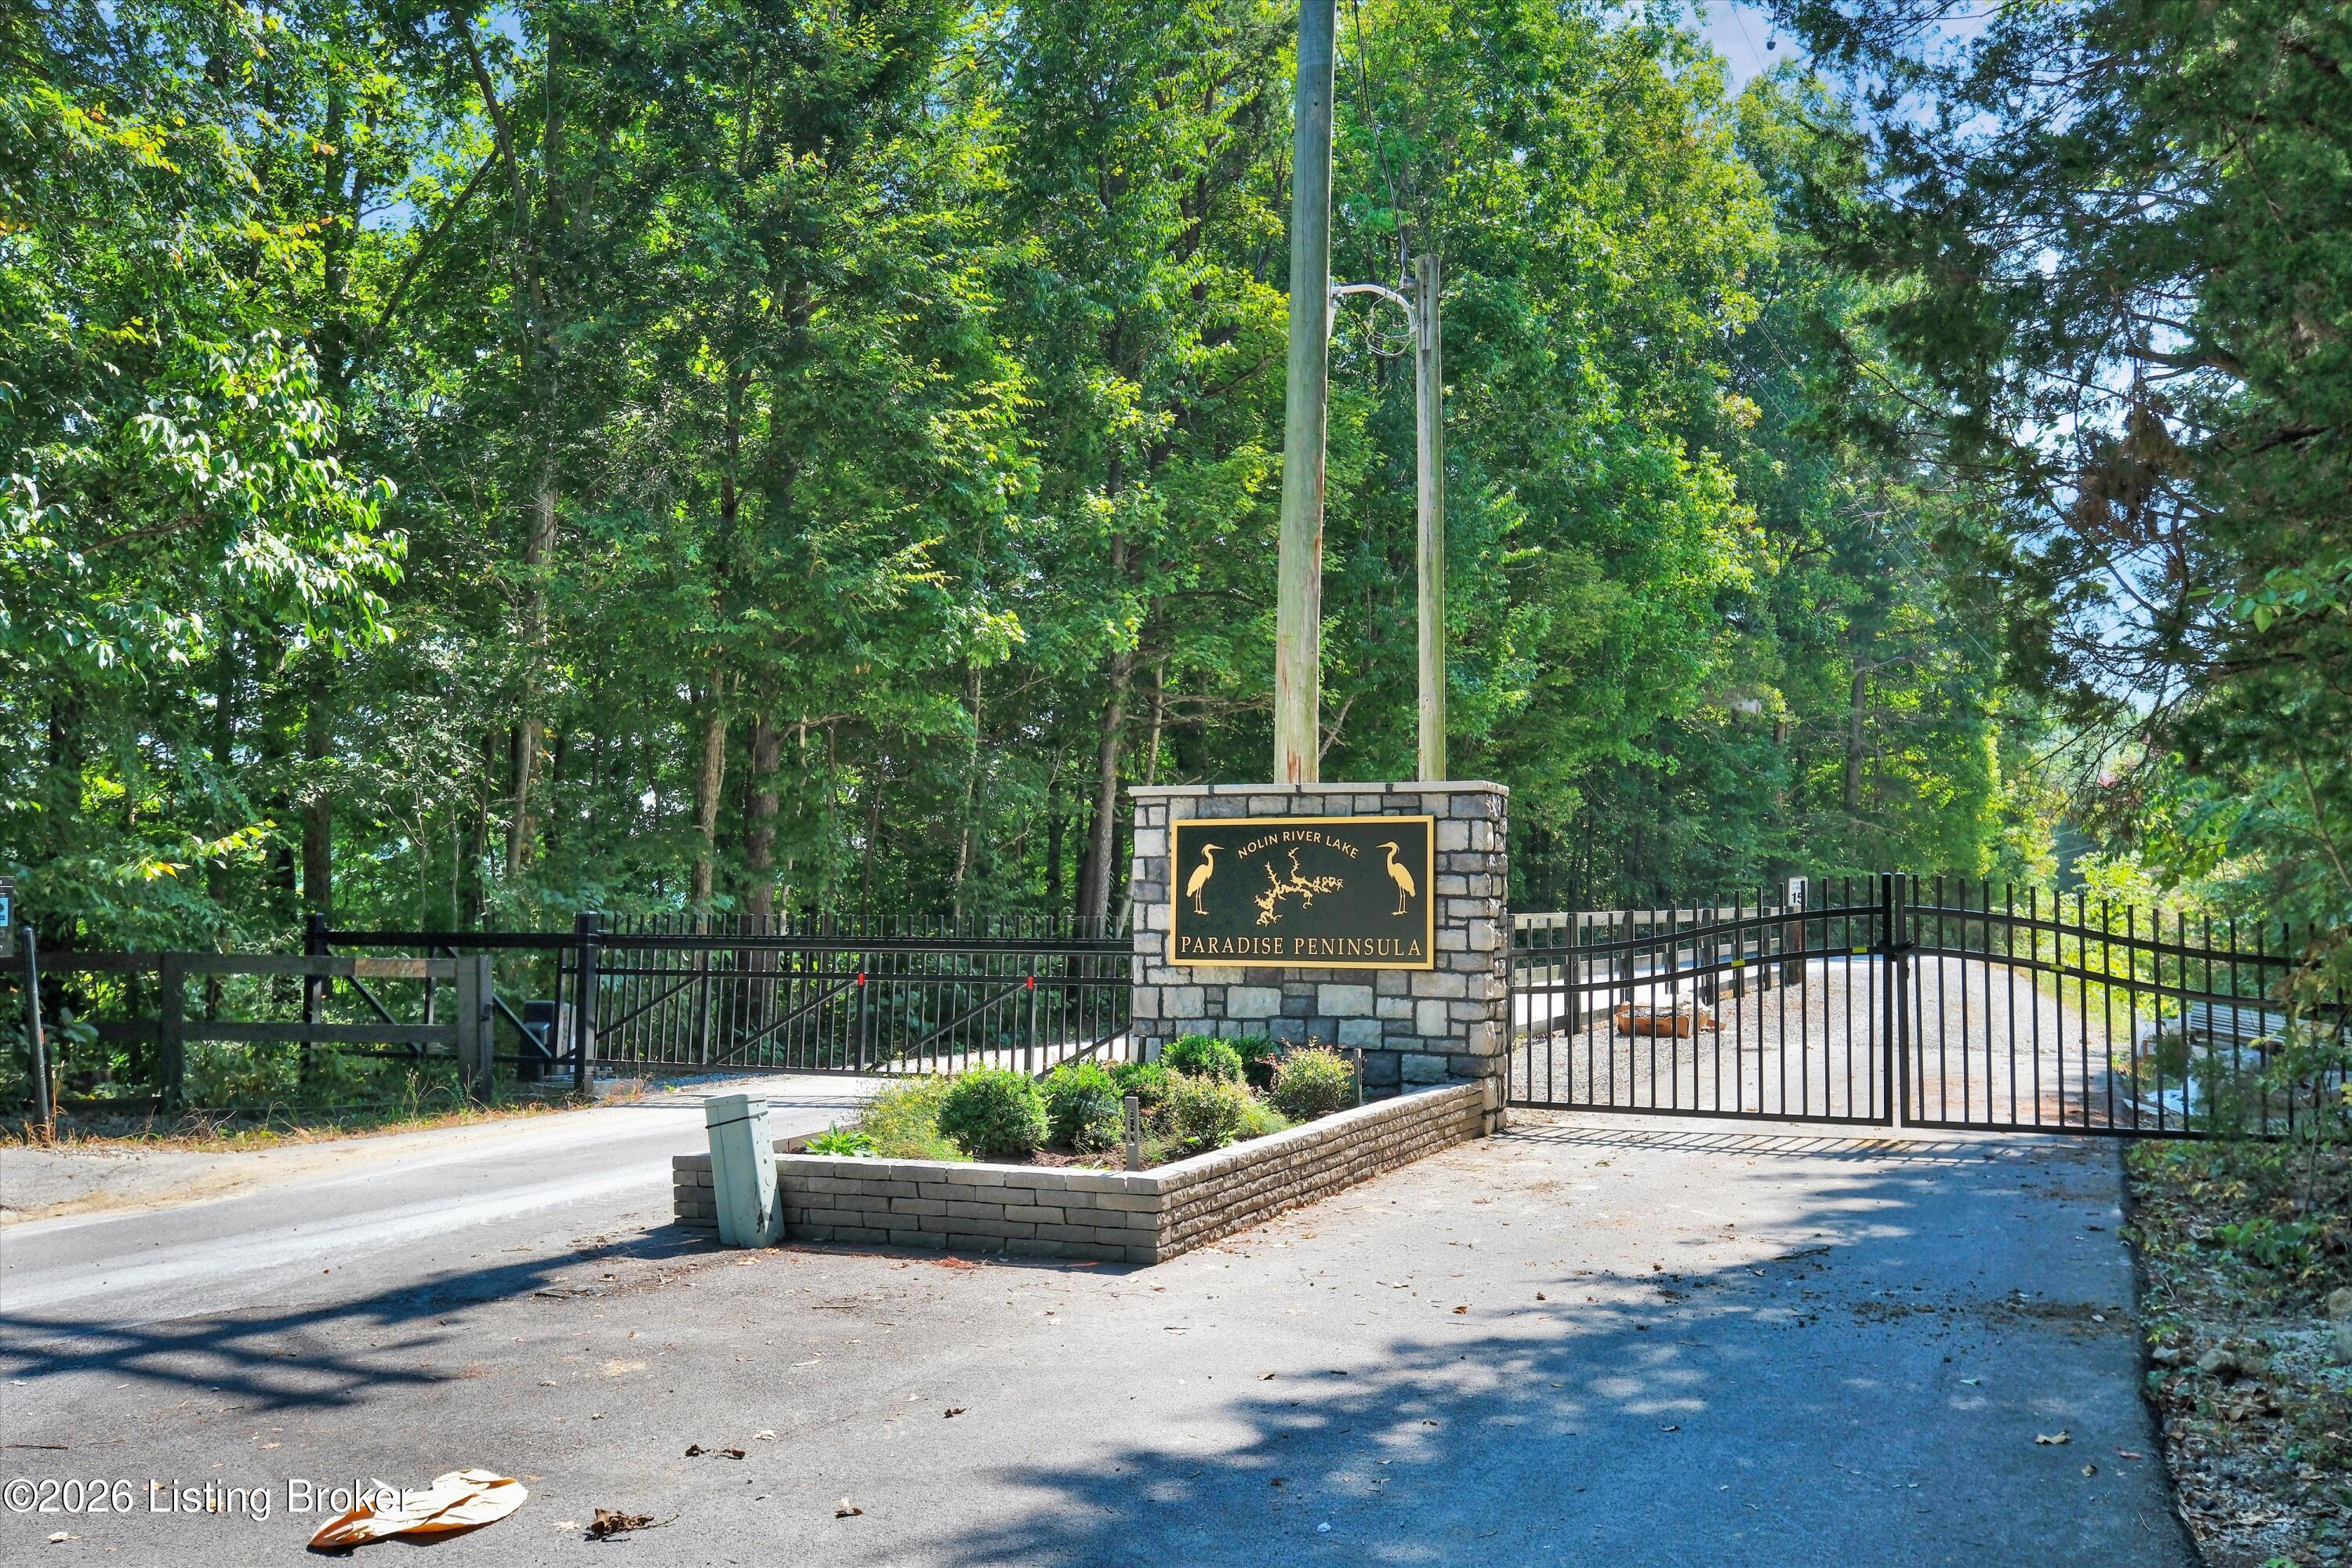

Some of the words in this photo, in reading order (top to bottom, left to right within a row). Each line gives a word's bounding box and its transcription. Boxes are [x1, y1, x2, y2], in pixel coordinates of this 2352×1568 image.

[1237, 833, 1278, 859] NOLIN
[1283, 830, 1321, 844] RIVER
[1326, 836, 1359, 859] LAKE
[1181, 936, 1284, 954] PARADISE
[1294, 938, 1421, 956] PENINSULA
